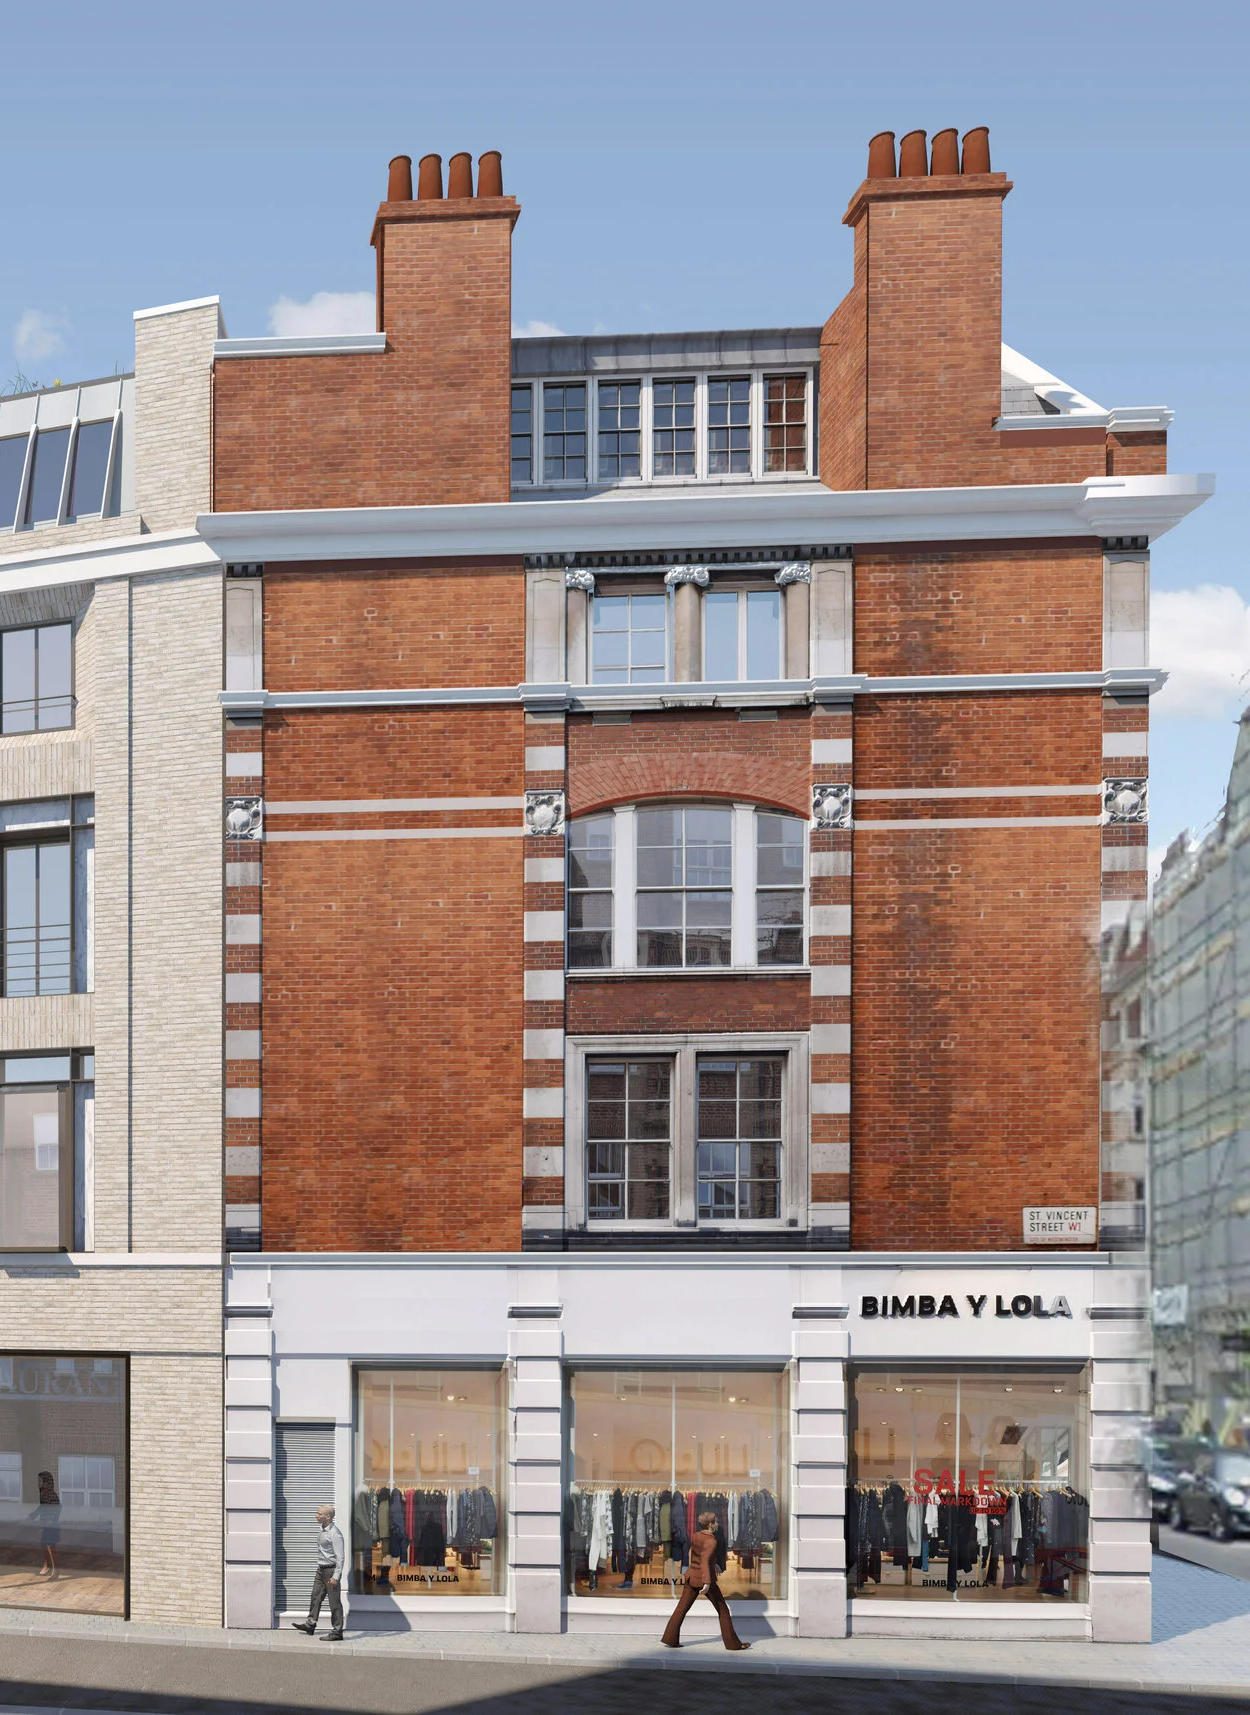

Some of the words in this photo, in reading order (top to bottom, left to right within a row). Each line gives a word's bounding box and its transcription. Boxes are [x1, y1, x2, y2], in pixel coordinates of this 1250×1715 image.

[1029, 1211, 1042, 1221] ST.
[1046, 1210, 1088, 1220] VINCENT
[1029, 1222, 1064, 1232] STREET
[1068, 1222, 1081, 1232] W1
[860, 1295, 959, 1317] BIMBA
[965, 1295, 988, 1317] Y
[995, 1295, 1072, 1317] LOLA
[913, 1468, 995, 1495] SALE
[907, 1495, 938, 1506] FINAL
[941, 1497, 1007, 1507] MARKDOWN
[397, 1574, 426, 1582] BIMBA
[640, 1577, 670, 1585] BIMBA
[922, 1580, 953, 1588] BIMB
[955, 1580, 962, 1588] Y
[964, 1580, 989, 1588] LOLA
